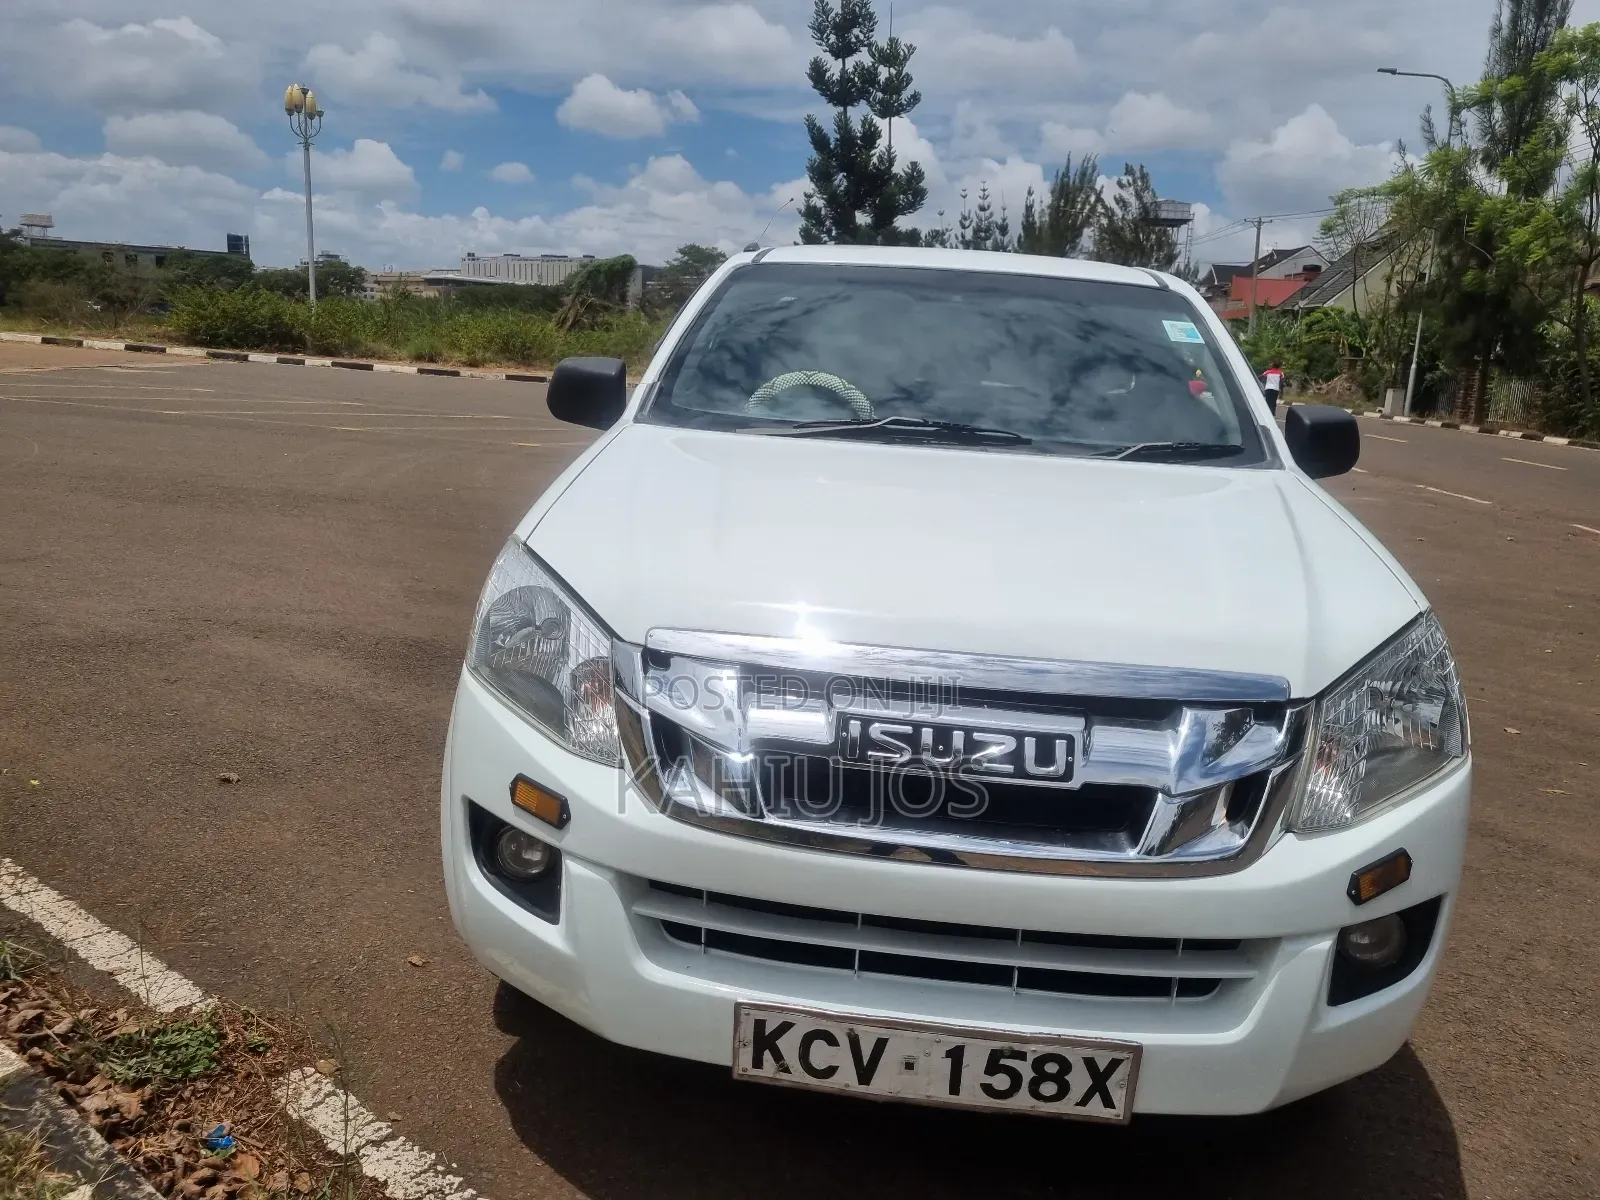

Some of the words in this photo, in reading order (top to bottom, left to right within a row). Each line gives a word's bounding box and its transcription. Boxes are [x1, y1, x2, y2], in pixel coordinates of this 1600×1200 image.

[846, 718, 1068, 777] ISUZU
[751, 1018, 890, 1086] KCV
[944, 1043, 1124, 1110] 158X
